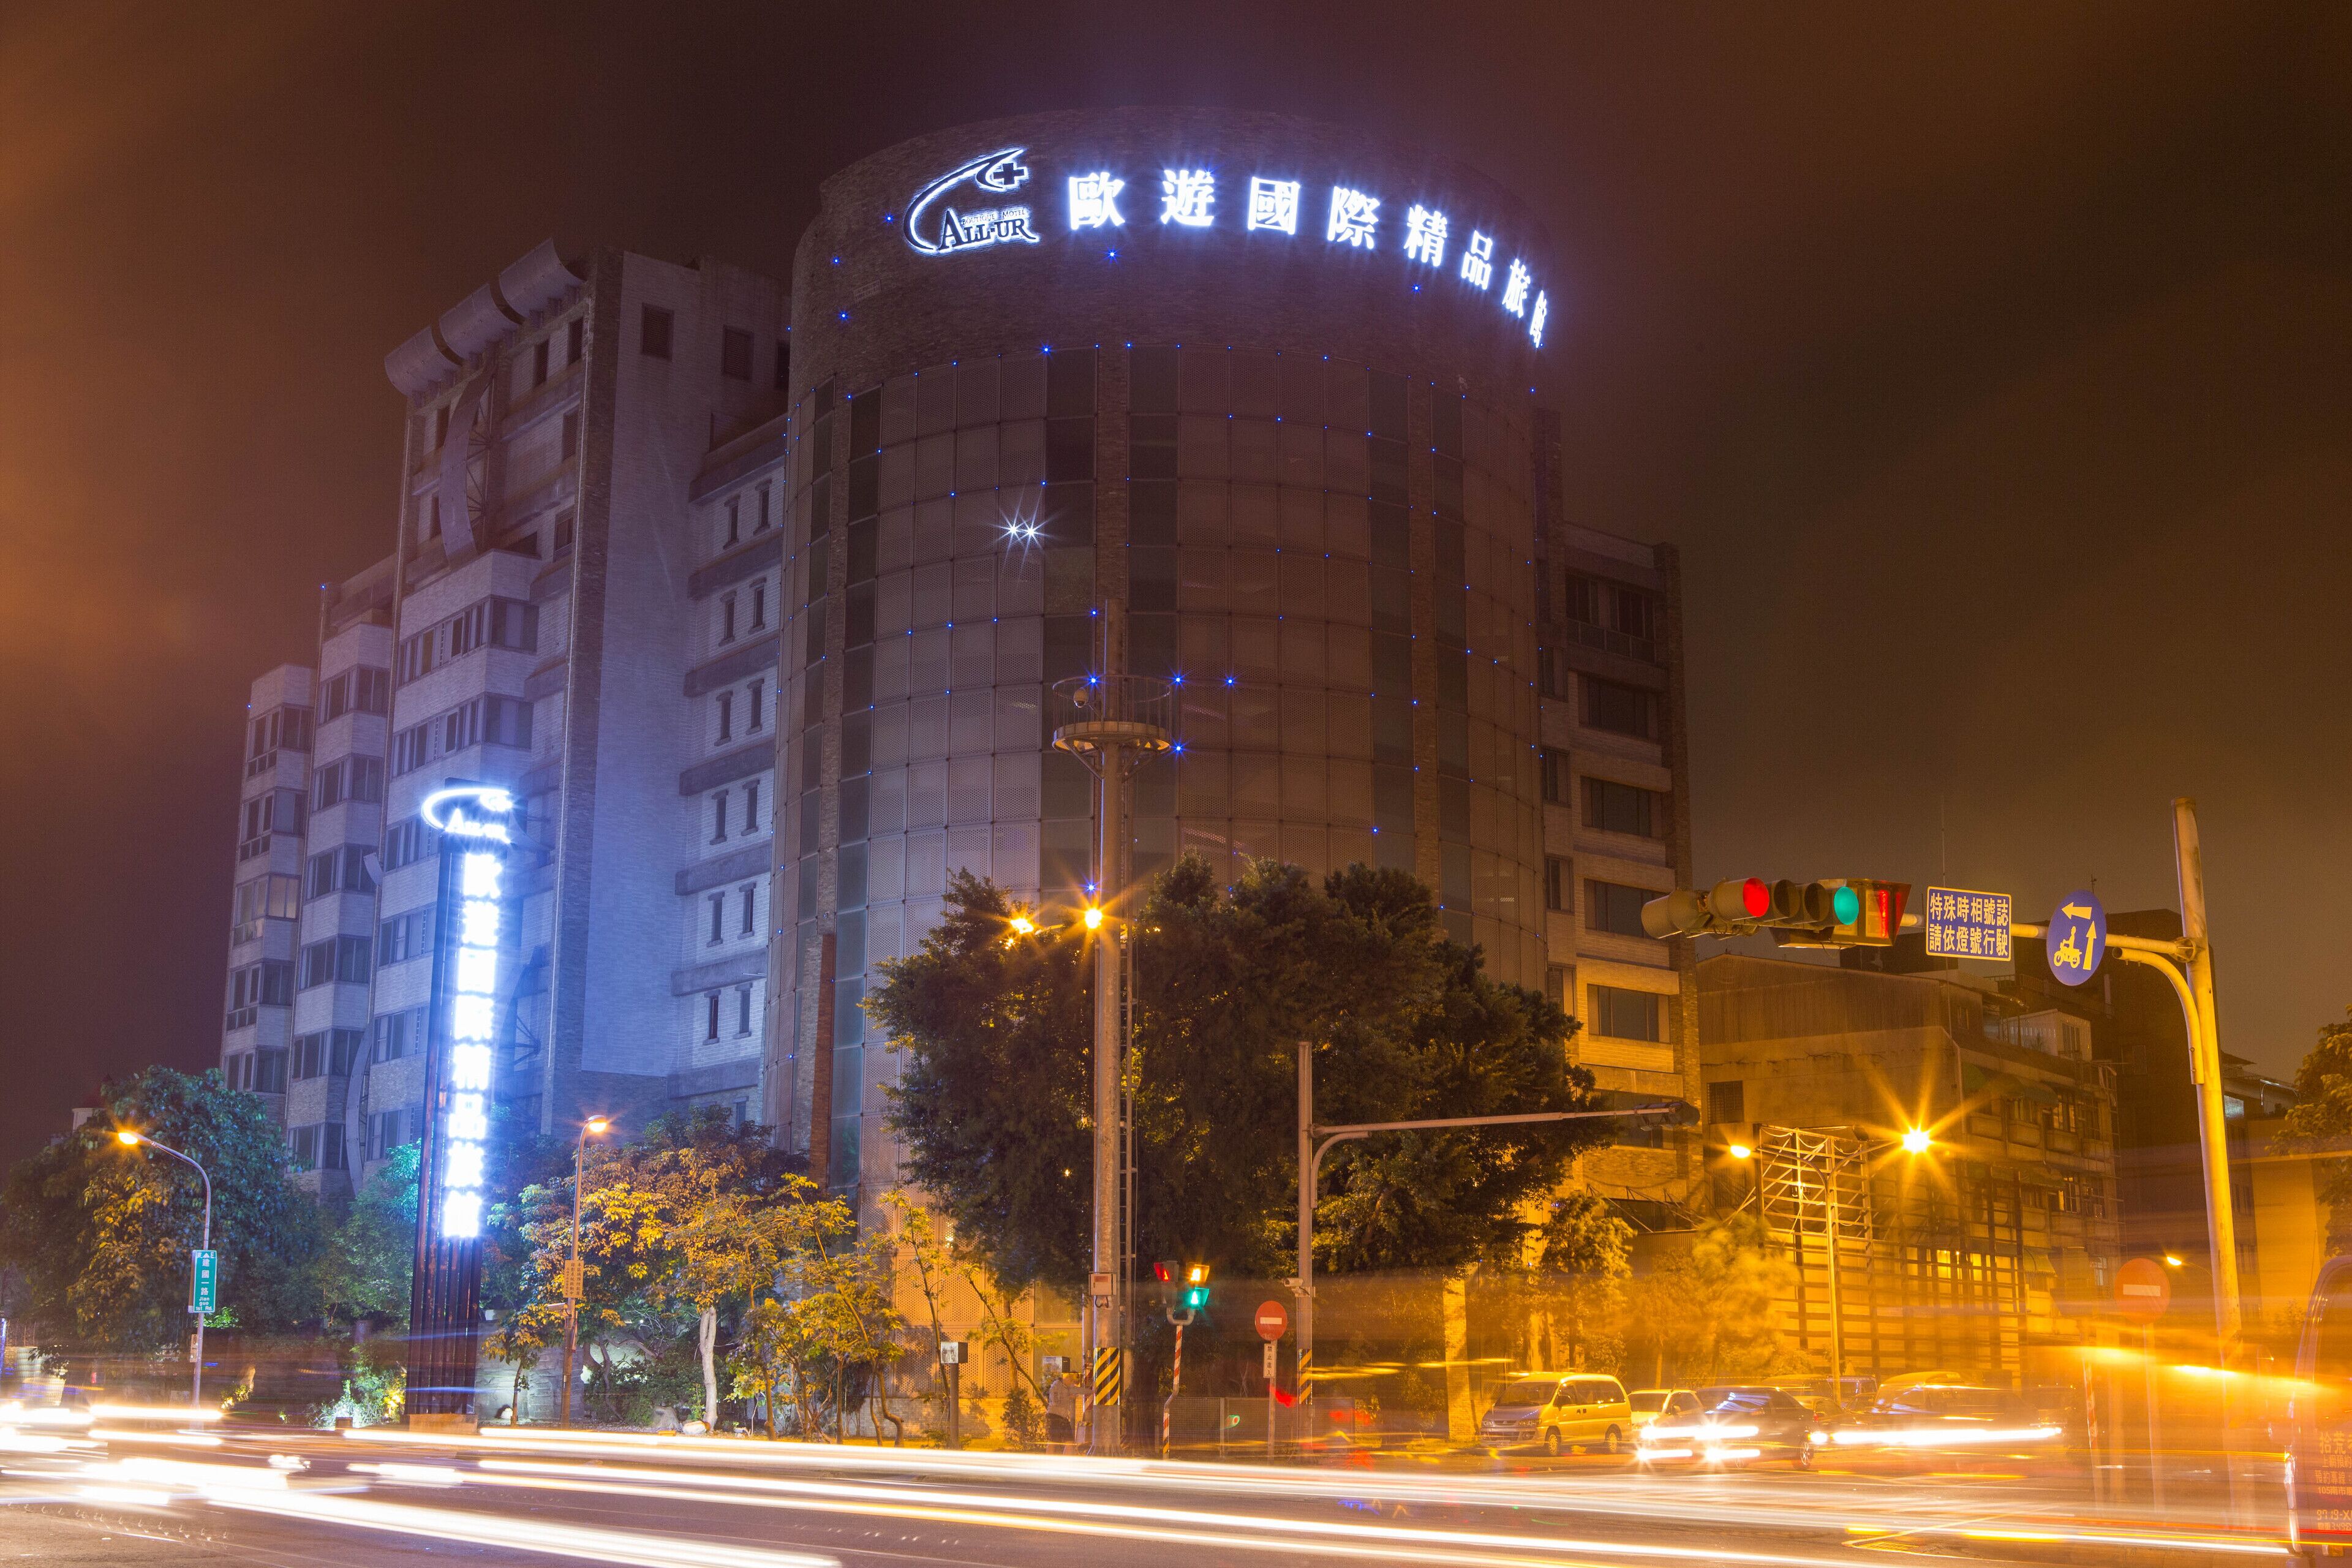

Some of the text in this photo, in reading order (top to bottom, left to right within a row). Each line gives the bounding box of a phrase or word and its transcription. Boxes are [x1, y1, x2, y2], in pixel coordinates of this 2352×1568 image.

[962, 209, 1025, 225] BOUTIQUE MOTEL
[1929, 892, 2009, 927] 特殊時相號誌
[1929, 924, 2008, 956] 請依燈號行駛
[2316, 1509, 2352, 1520] 9719-X
